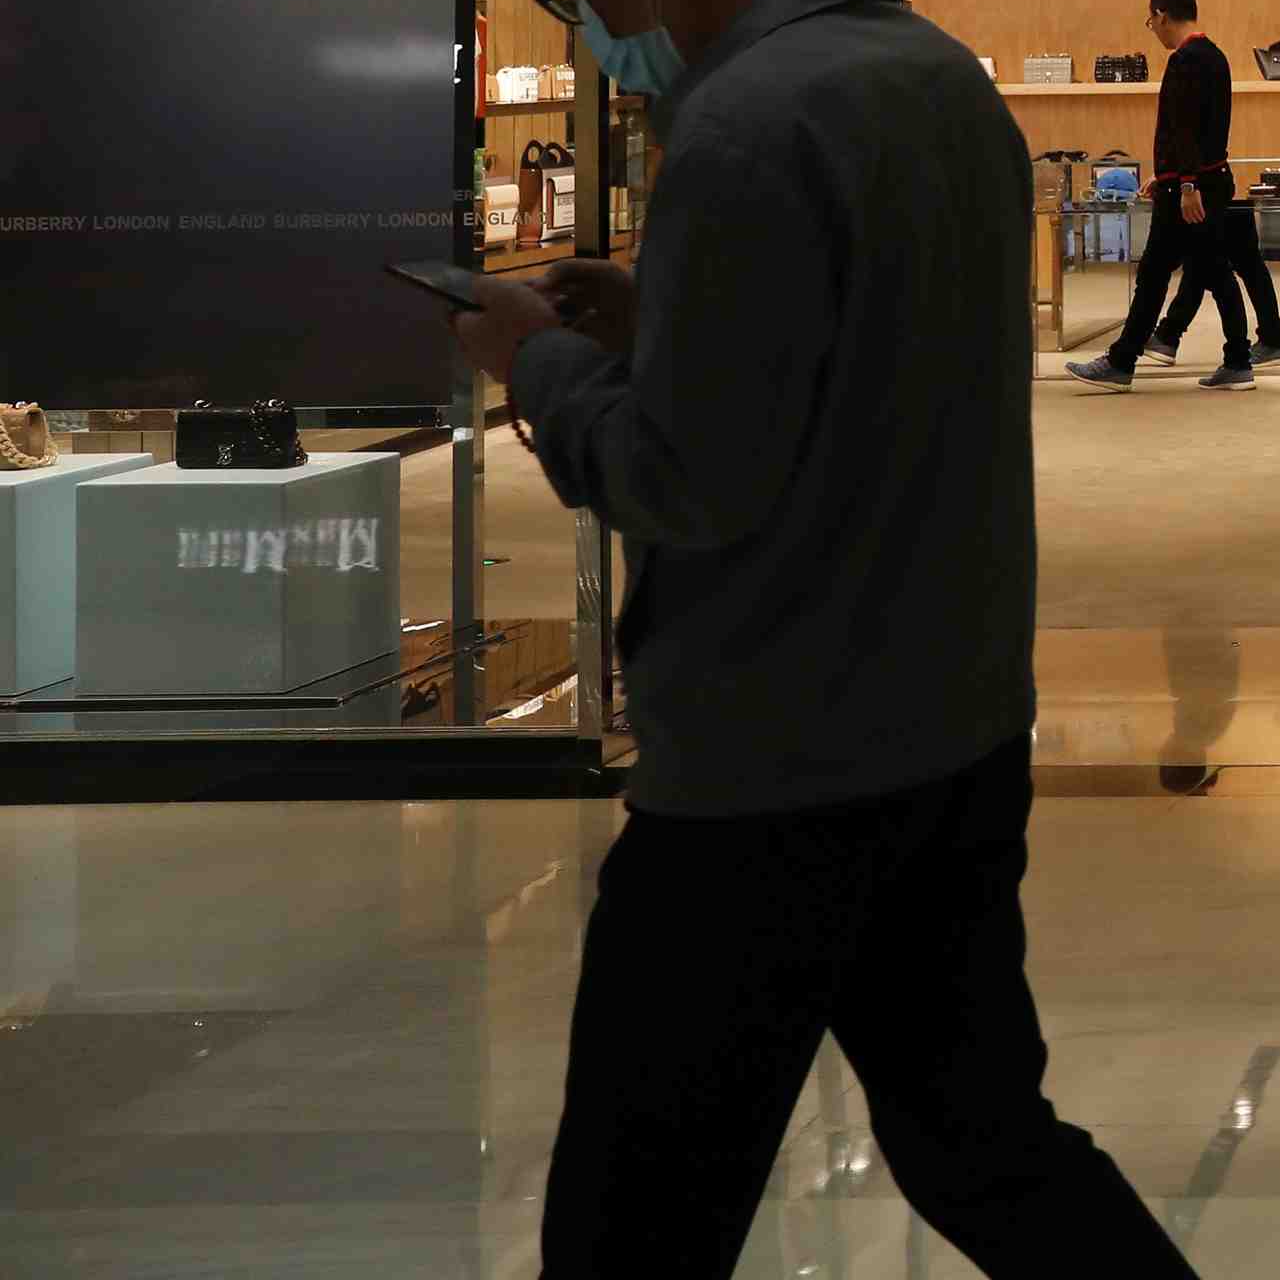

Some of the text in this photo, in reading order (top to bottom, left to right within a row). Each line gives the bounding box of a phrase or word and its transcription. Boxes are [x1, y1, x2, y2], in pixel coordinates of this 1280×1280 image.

[92, 215, 171, 231] LONDON
[177, 214, 266, 231] ENGLAND
[272, 211, 371, 229] BURBERRY
[377, 211, 453, 227] LONDON
